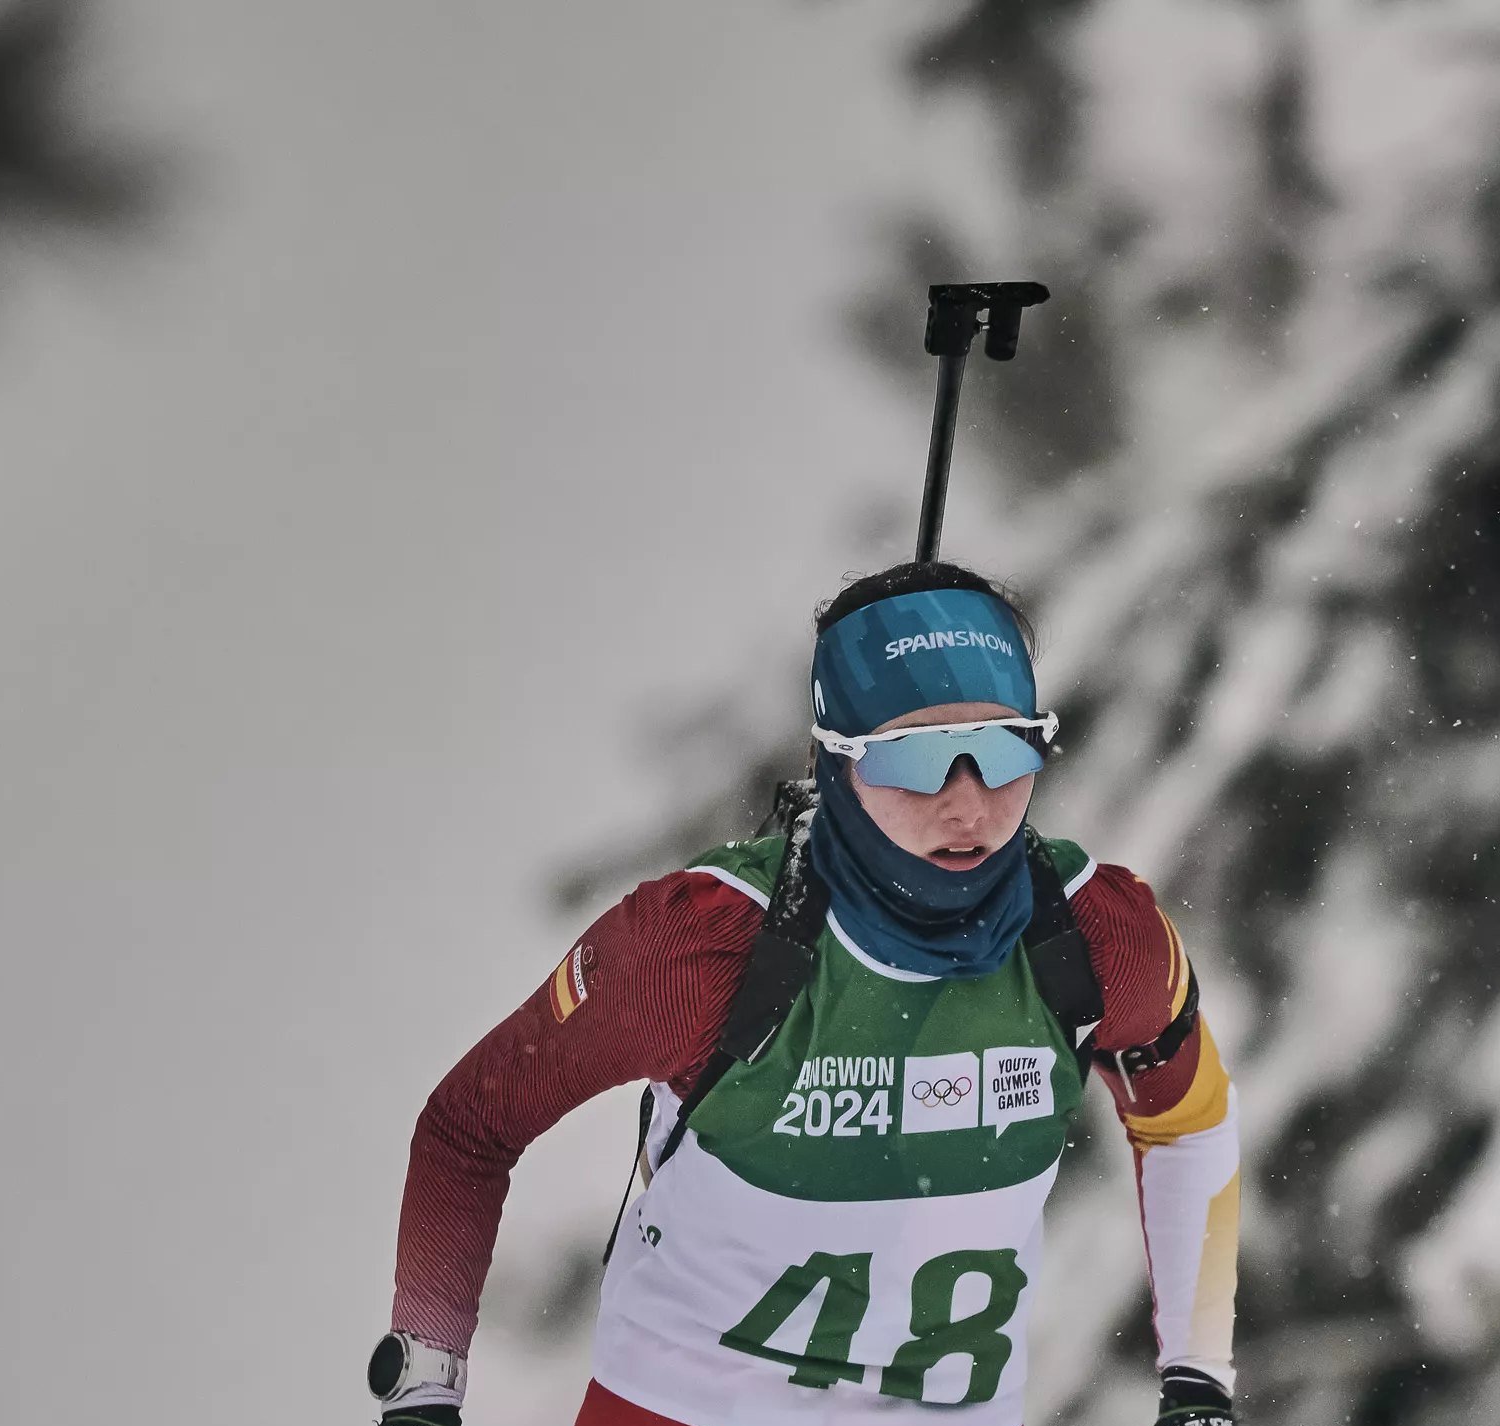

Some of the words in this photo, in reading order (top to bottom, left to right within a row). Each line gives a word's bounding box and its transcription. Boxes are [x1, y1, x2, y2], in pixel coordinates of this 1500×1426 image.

[885, 631, 1013, 660] SPAINSNOW
[793, 1056, 895, 1090] ANGWON
[999, 1057, 1037, 1074] YOUTH
[992, 1071, 1041, 1093] OLYMPIC
[772, 1090, 893, 1137] 2024
[998, 1089, 1039, 1110] GAMES
[718, 1248, 1028, 1404] 48
